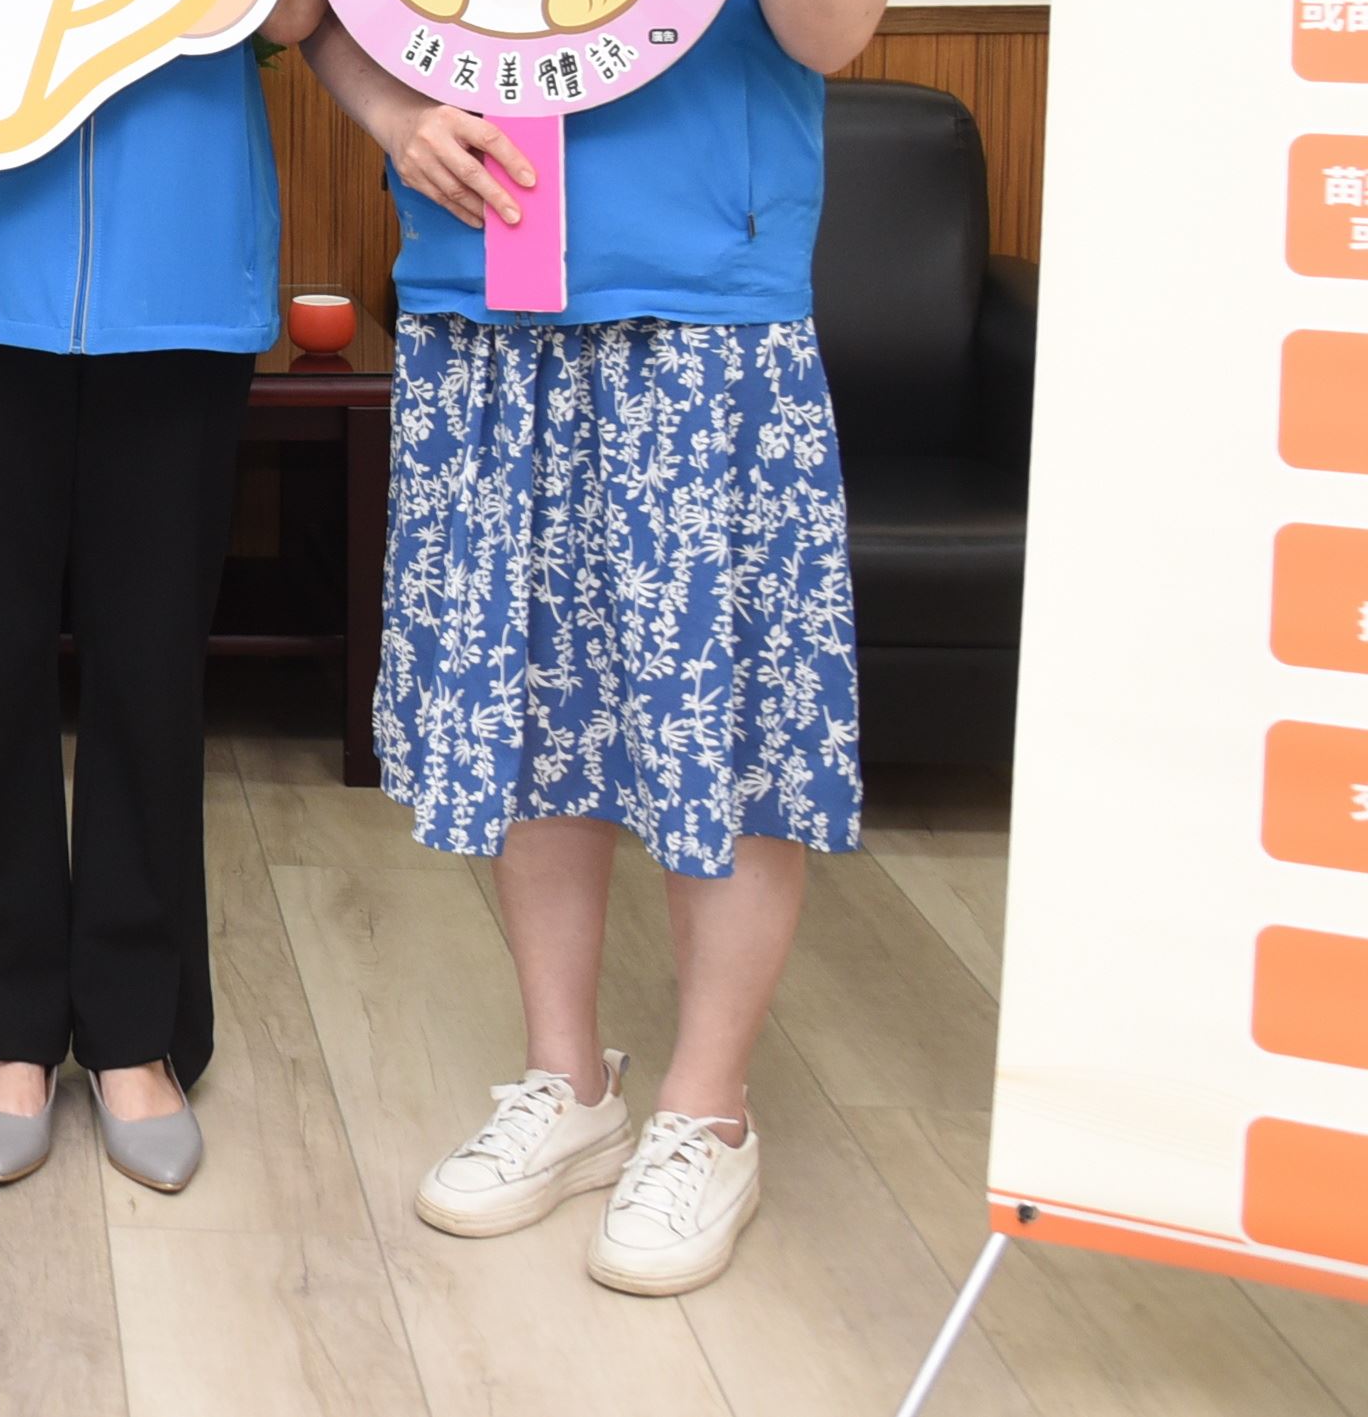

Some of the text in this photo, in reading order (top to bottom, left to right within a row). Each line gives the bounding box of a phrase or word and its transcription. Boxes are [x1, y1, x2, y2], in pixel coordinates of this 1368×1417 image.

[406, 28, 635, 100] 請友善體諒
[1322, 165, 1368, 207] 苗
